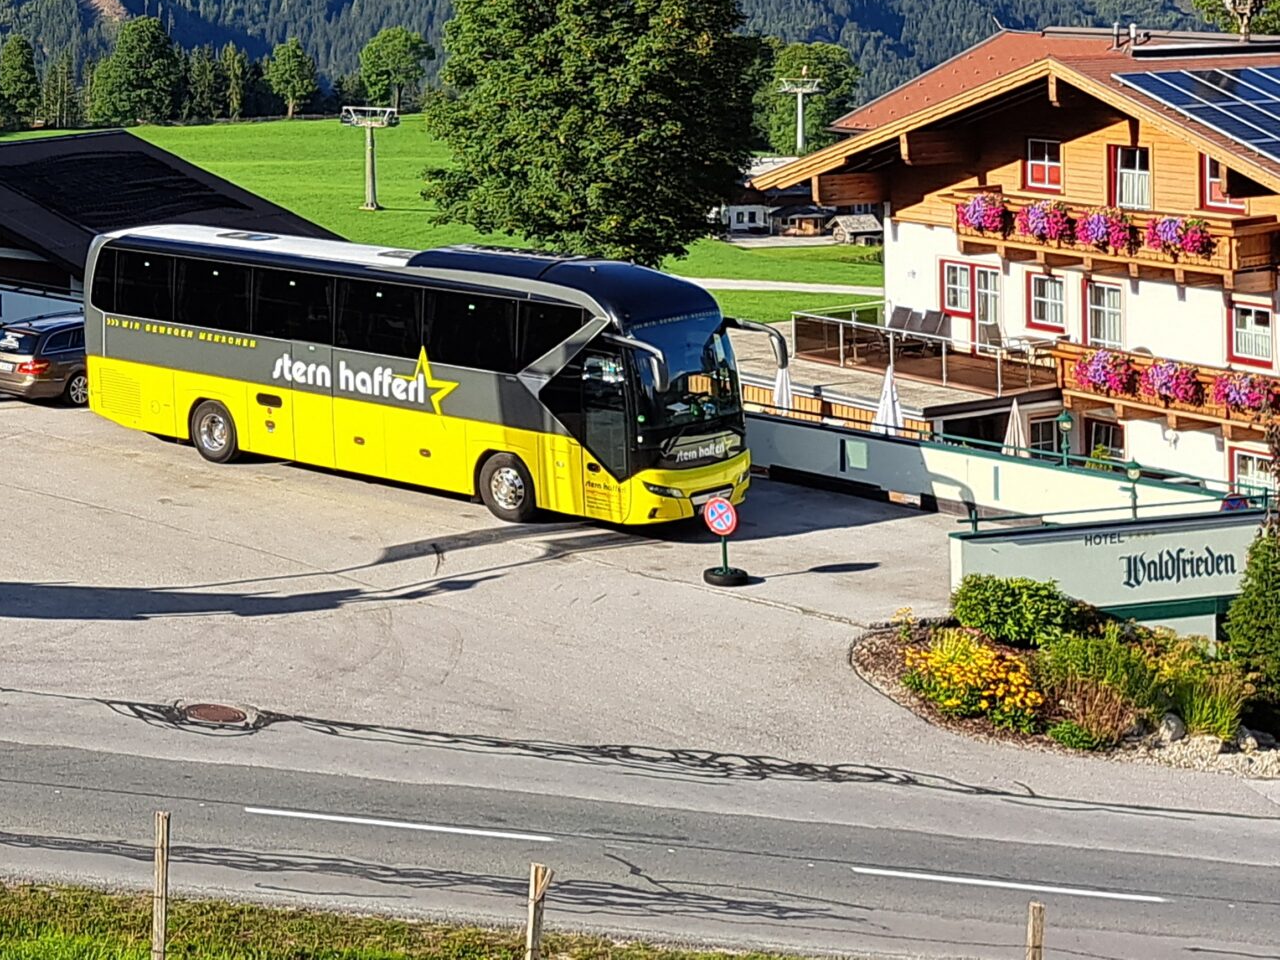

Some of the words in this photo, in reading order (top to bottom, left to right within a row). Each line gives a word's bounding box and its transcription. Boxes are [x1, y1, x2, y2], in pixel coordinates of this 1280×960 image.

[121, 320, 140, 331] WIR
[272, 353, 332, 388] stern
[339, 360, 425, 404] hafferl
[1084, 532, 1125, 546] HOTEL
[1119, 546, 1237, 588] Waldfrieden
